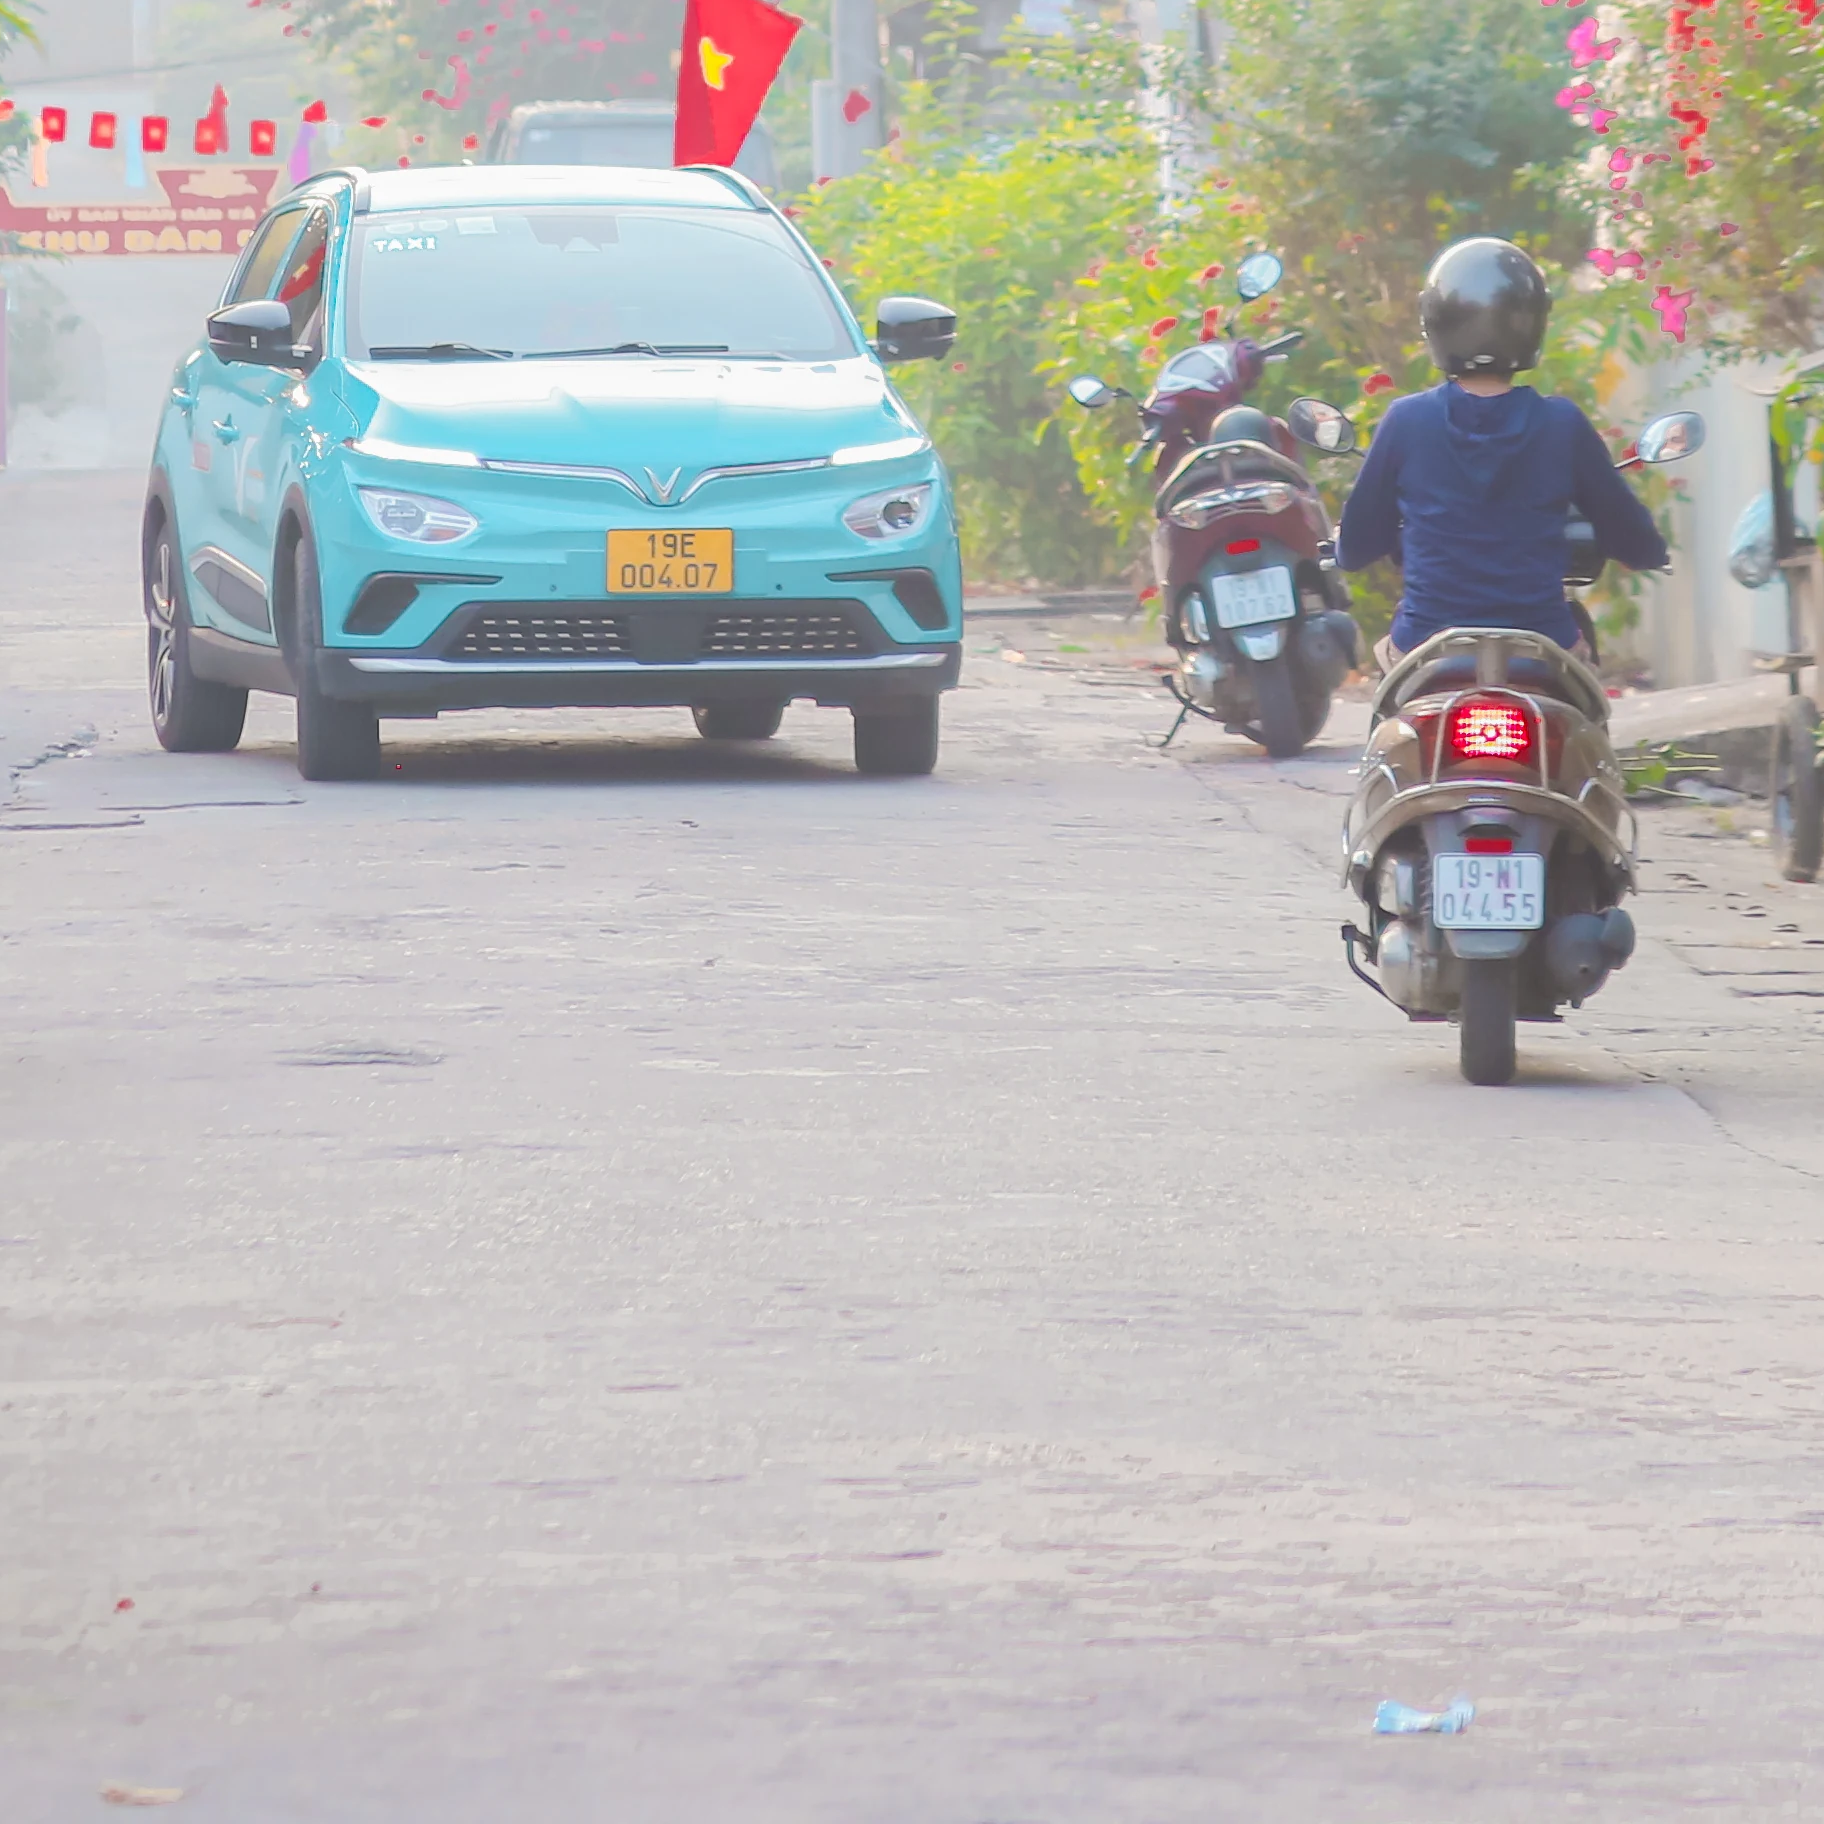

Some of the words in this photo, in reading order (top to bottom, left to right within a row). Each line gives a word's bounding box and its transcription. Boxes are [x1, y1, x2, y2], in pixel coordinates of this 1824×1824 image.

[372, 237, 437, 253] TAXI
[647, 533, 696, 558] 19E
[621, 563, 718, 588] 004.07
[1442, 892, 1536, 922] 044.55
